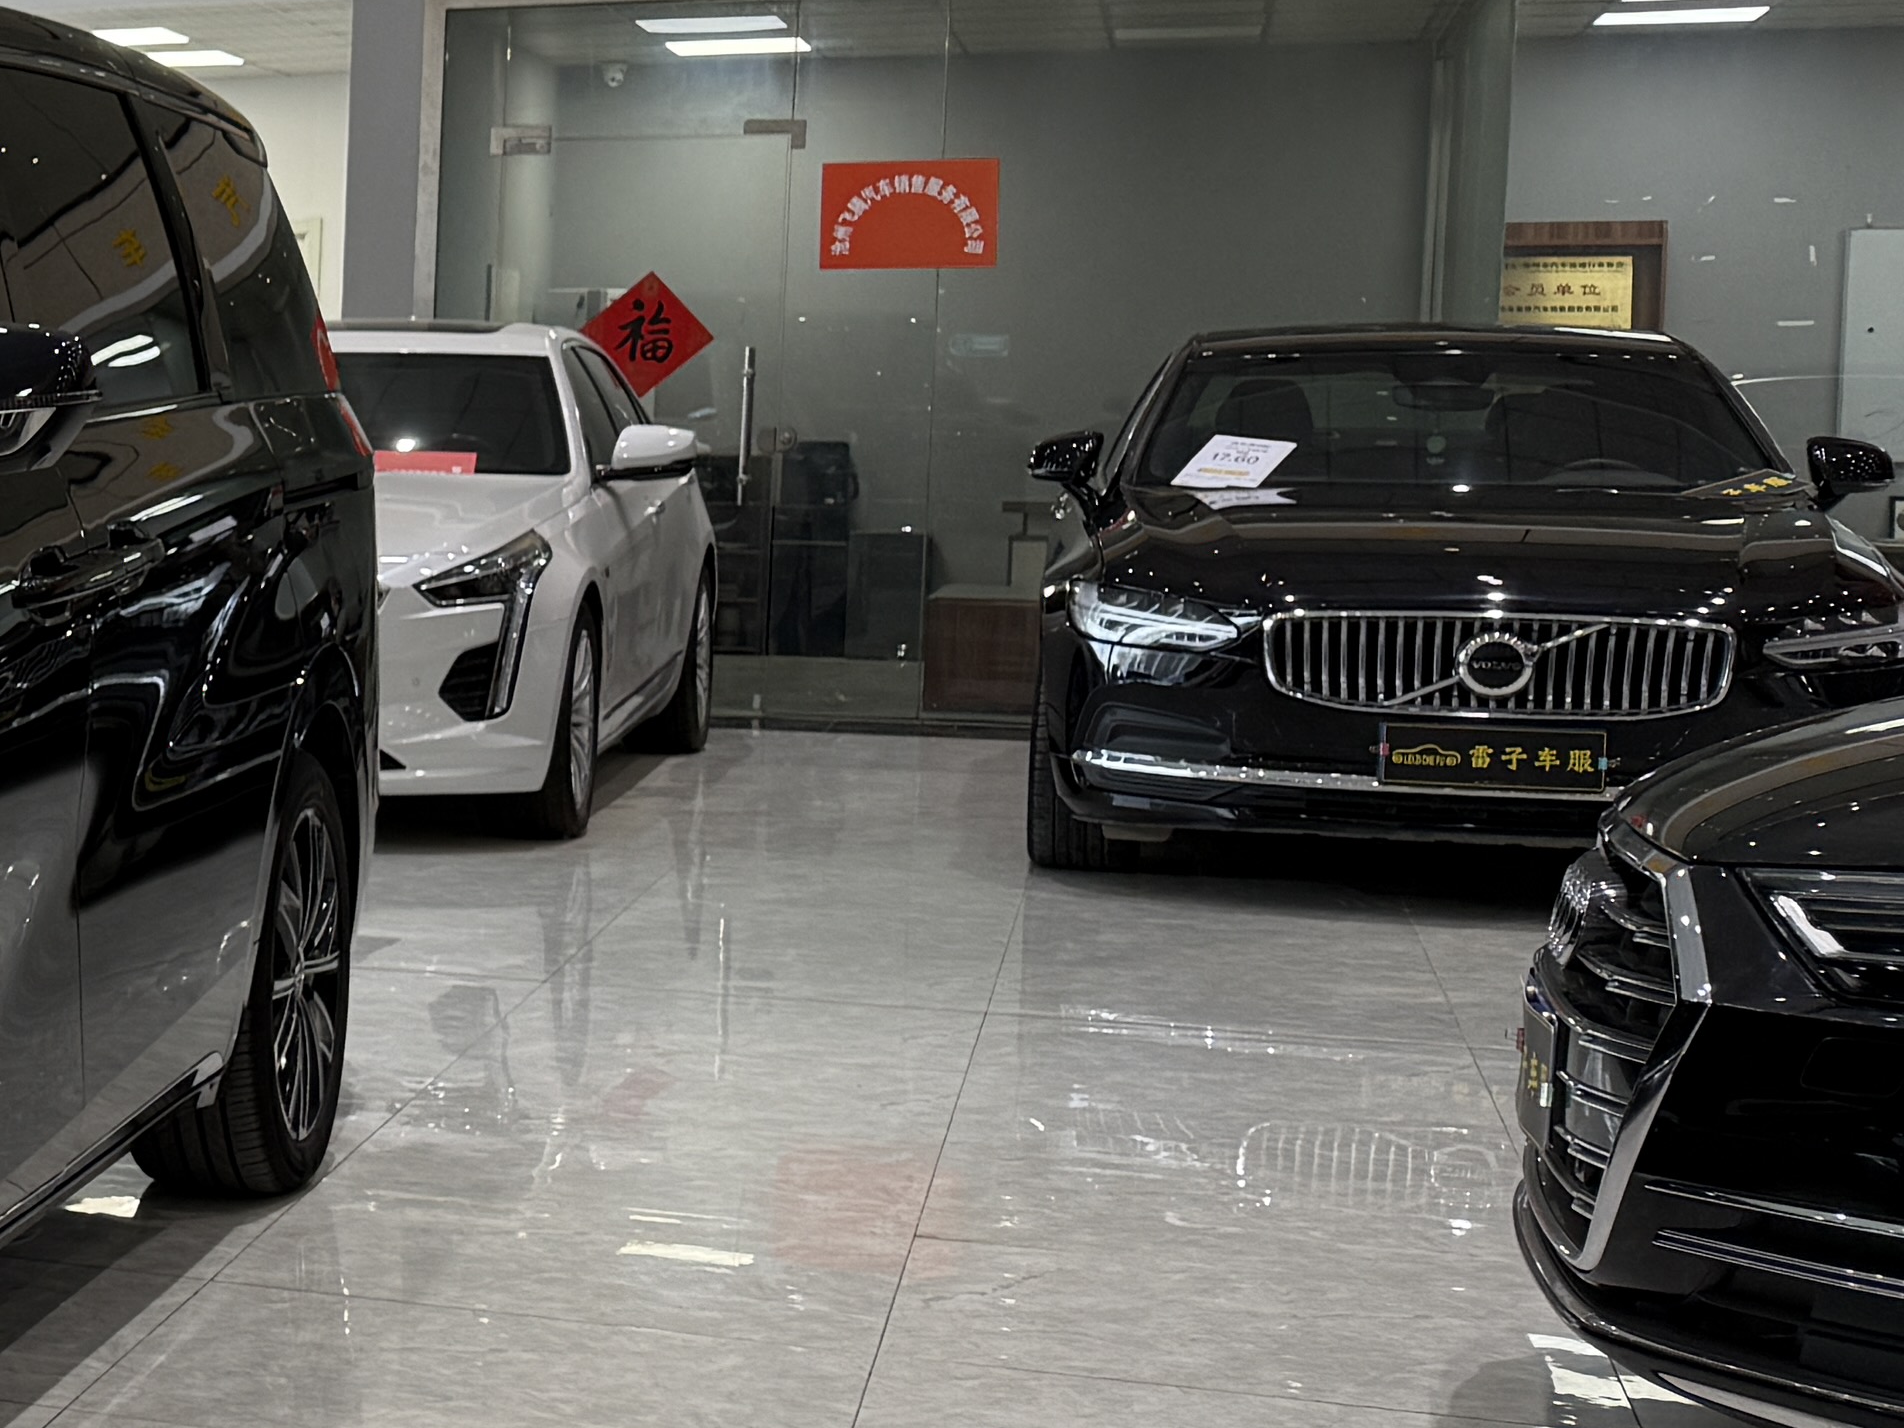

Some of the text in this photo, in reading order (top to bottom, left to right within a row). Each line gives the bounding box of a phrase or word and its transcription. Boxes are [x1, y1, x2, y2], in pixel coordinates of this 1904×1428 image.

[615, 299, 673, 363] 福
[1472, 660, 1522, 670] VOLVO
[1469, 745, 1595, 773] 雷子车服
